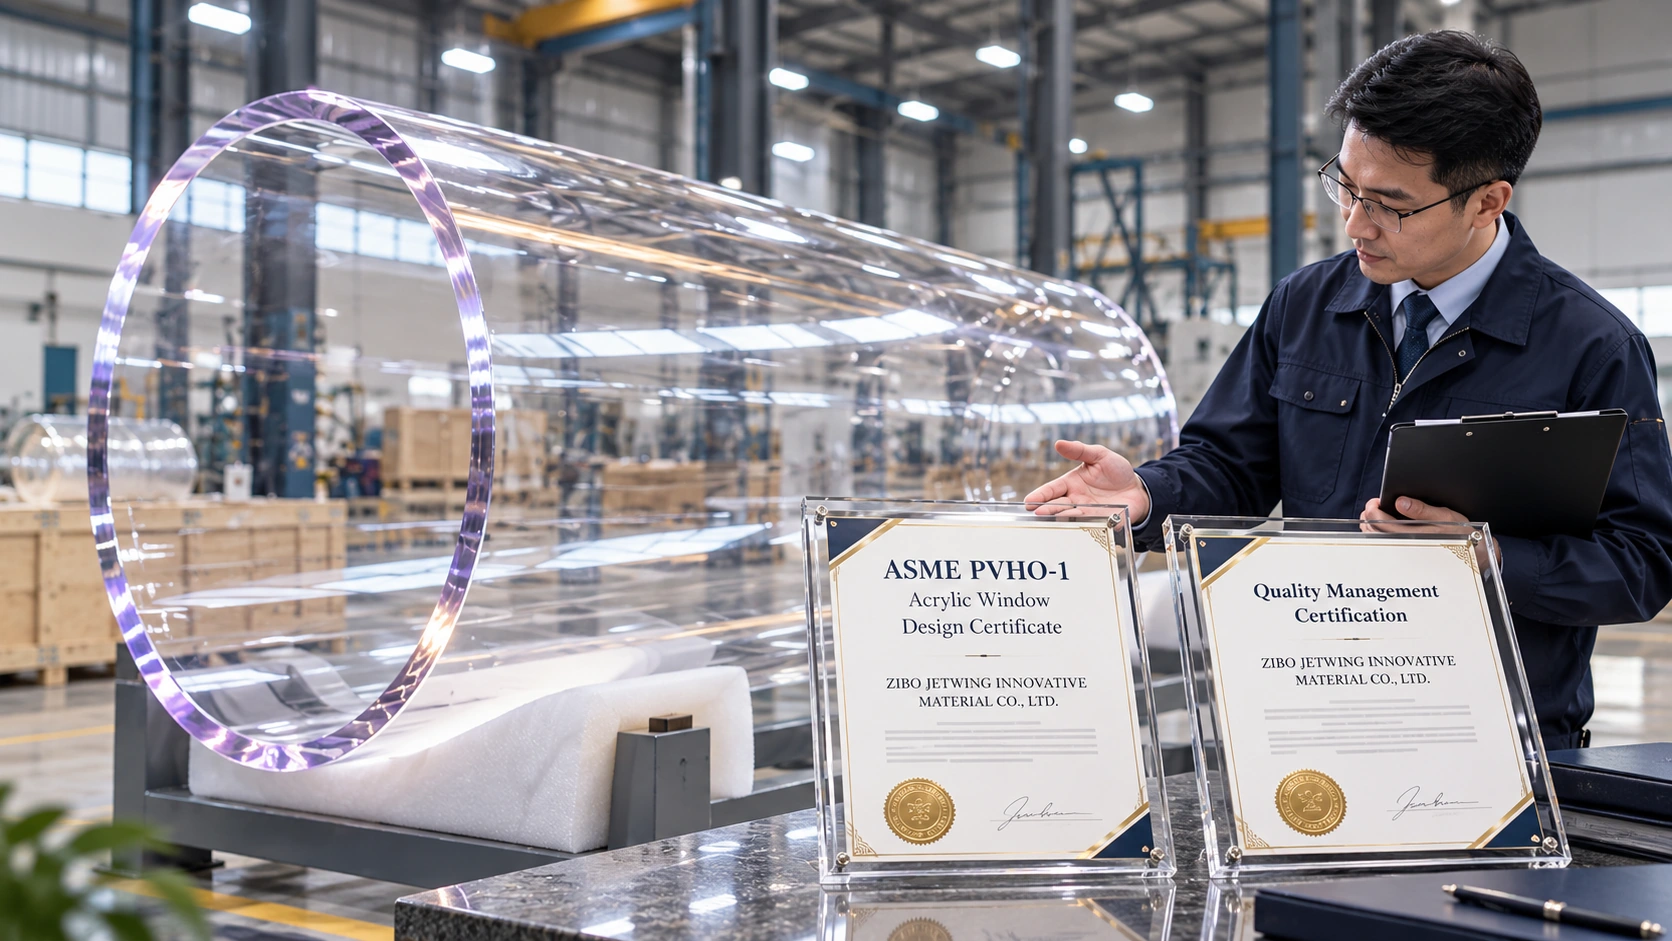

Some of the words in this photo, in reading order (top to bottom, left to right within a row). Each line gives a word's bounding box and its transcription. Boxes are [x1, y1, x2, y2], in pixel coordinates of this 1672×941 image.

[884, 560, 961, 579] ASME
[970, 560, 1069, 580] PVHO-1
[1254, 583, 1320, 602] Quality
[1326, 584, 1439, 602] Management
[910, 592, 971, 611] Acrylic
[977, 592, 1049, 607] Window
[1295, 607, 1407, 623] Certification
[903, 619, 964, 638] Design
[970, 618, 1061, 634] Certificate
[1261, 658, 1295, 668] ZIBO
[1301, 657, 1364, 669] JETWING
[1368, 656, 1456, 666] INNOVATIVE
[887, 678, 921, 688] ZIBO
[926, 678, 991, 691] JETWING
[996, 678, 1087, 688] INNOVATIVE
[1296, 674, 1367, 685] MATERIAL
[1371, 674, 1397, 685] CO.,
[1401, 673, 1430, 683] LTD.
[920, 696, 993, 707] MATERIAL
[997, 696, 1024, 708] CO.,
[1028, 696, 1058, 706] LTD.
